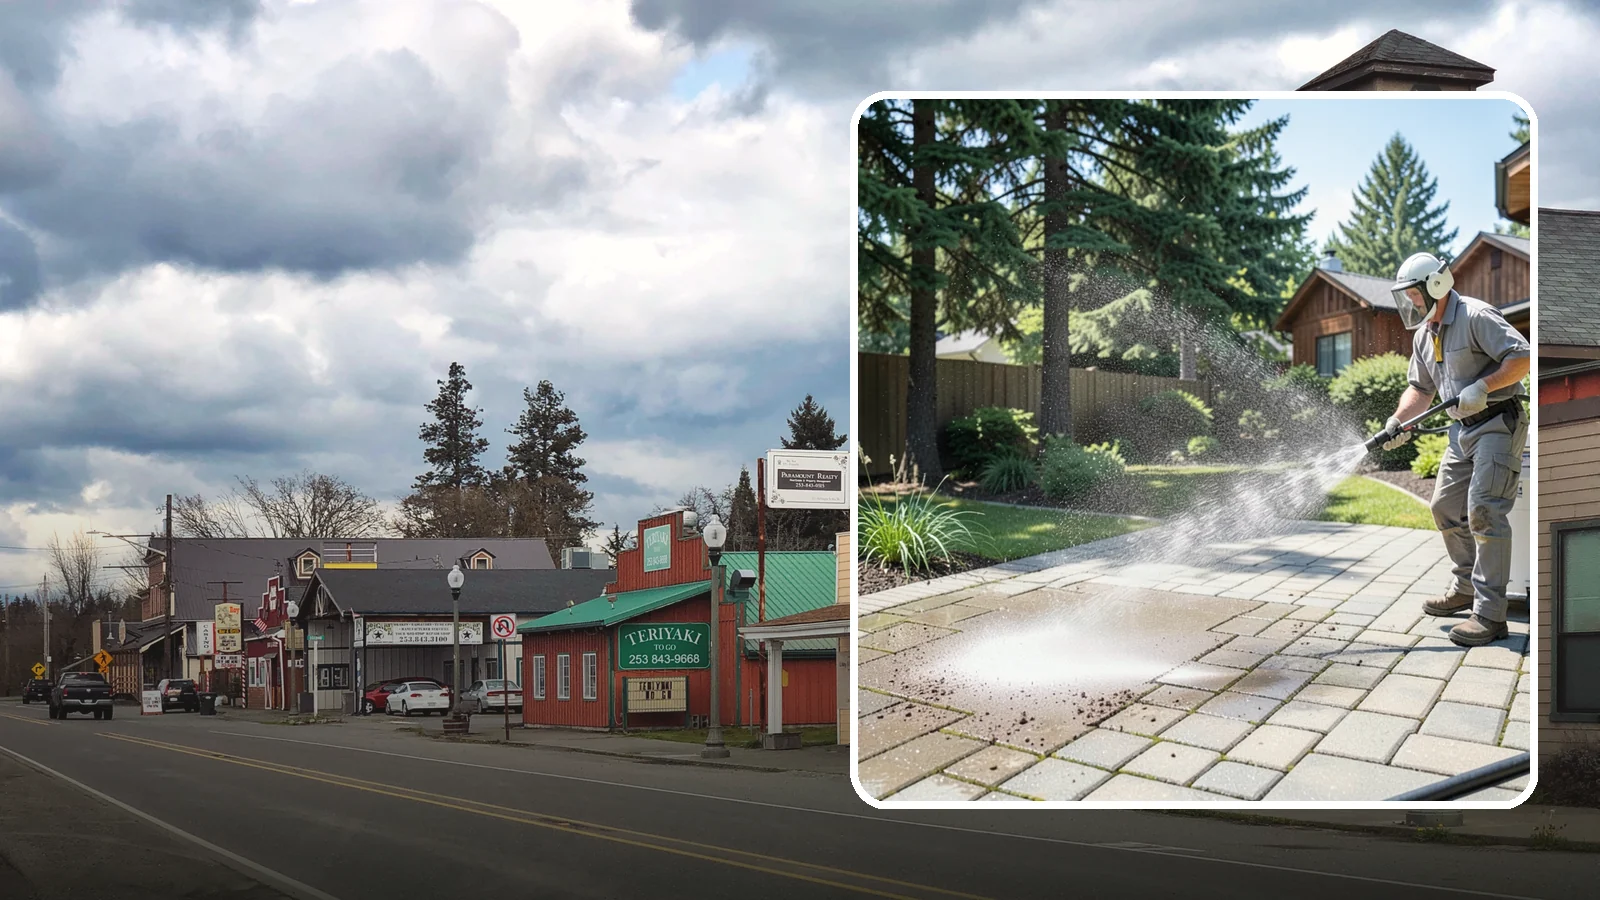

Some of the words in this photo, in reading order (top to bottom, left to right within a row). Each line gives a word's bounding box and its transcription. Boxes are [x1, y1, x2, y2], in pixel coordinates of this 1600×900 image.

[624, 627, 702, 646] TERIYAKI
[628, 654, 649, 665] 253
[651, 653, 700, 664] 843-9668
[639, 681, 673, 691] TERIYAKI
